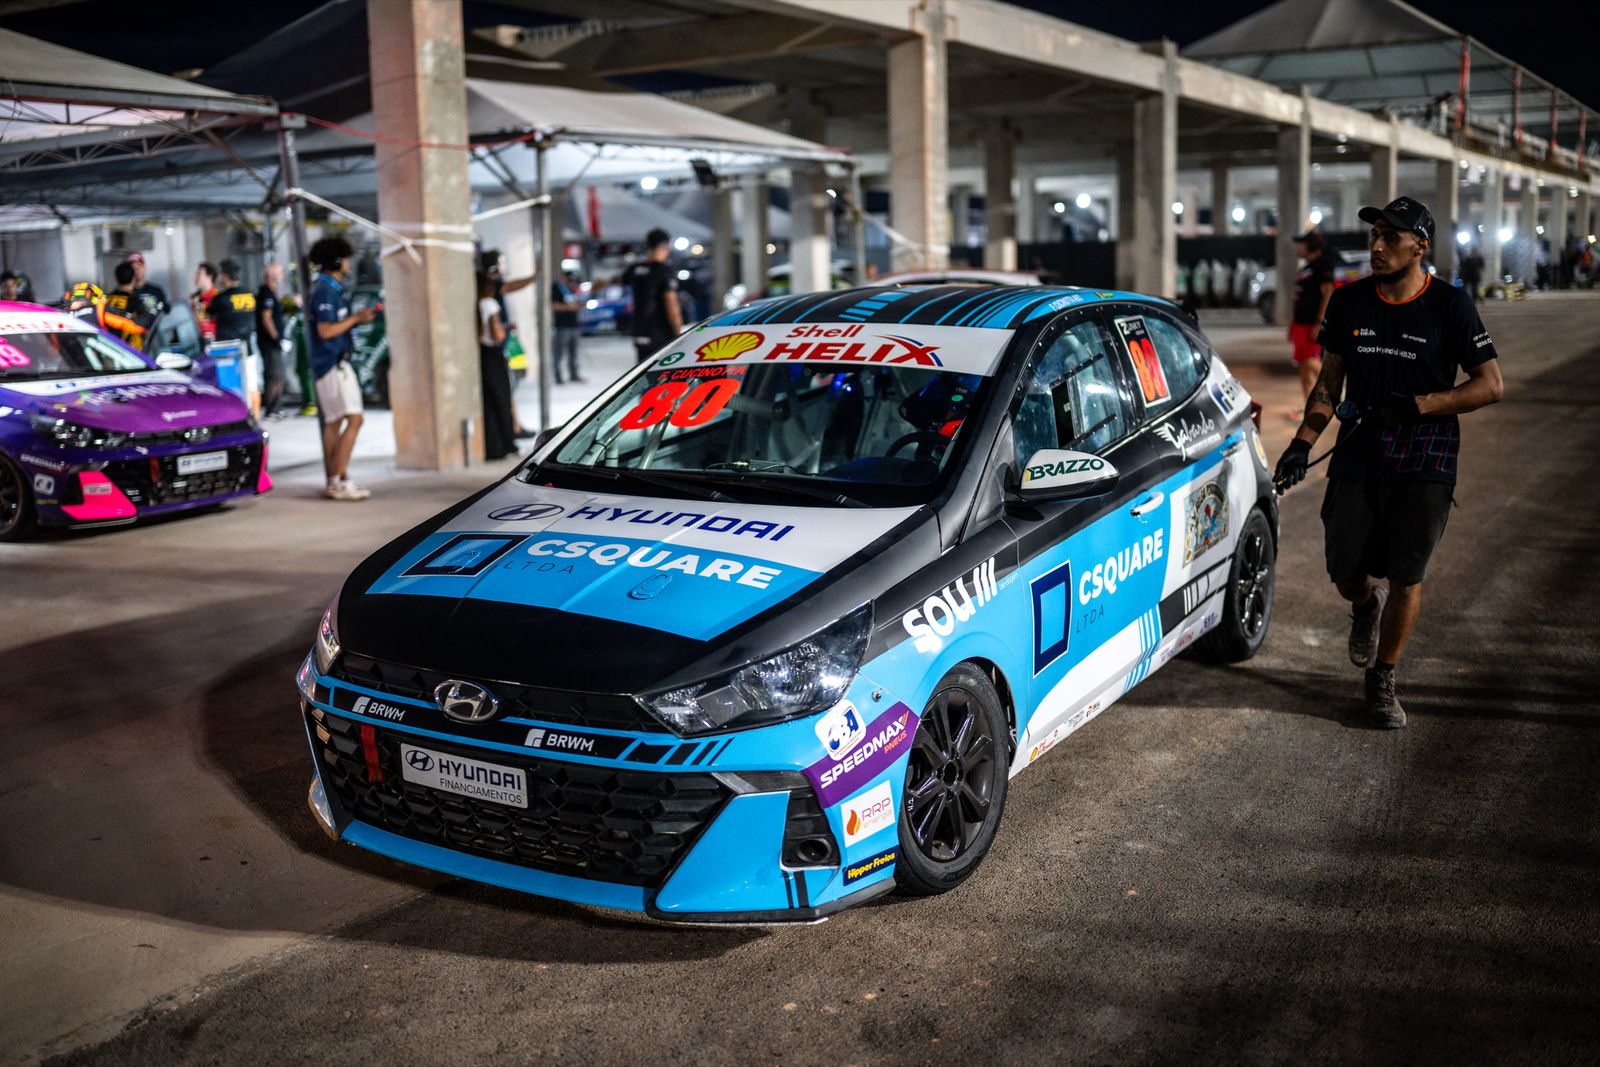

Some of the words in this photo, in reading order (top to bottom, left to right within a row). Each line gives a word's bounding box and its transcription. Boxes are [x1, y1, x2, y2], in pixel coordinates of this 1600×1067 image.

[786, 325, 865, 338] Shell
[763, 334, 944, 367] HELIX
[1399, 350, 1416, 359] HB20
[671, 365, 747, 380] CUCINOTTA
[1129, 338, 1167, 402] 80
[618, 378, 740, 430] 80
[1024, 459, 1104, 482] BRAZZO
[566, 506, 795, 541] HYUNDAI
[503, 559, 575, 575] LTDA
[527, 539, 782, 590] CSQUARE
[1079, 528, 1163, 606] CSQUARE
[1076, 604, 1105, 634] LTDA
[368, 703, 405, 722] BRWM
[546, 734, 595, 752] BRWM
[820, 711, 909, 790] SPEEDMAX
[884, 731, 908, 755] PNEUS
[438, 758, 522, 791] HYUNDAI
[439, 778, 522, 804] FINANCIAMENTOS
[861, 797, 892, 822] RRP
[847, 861, 874, 881] Hipper
[872, 851, 896, 871] Freios
